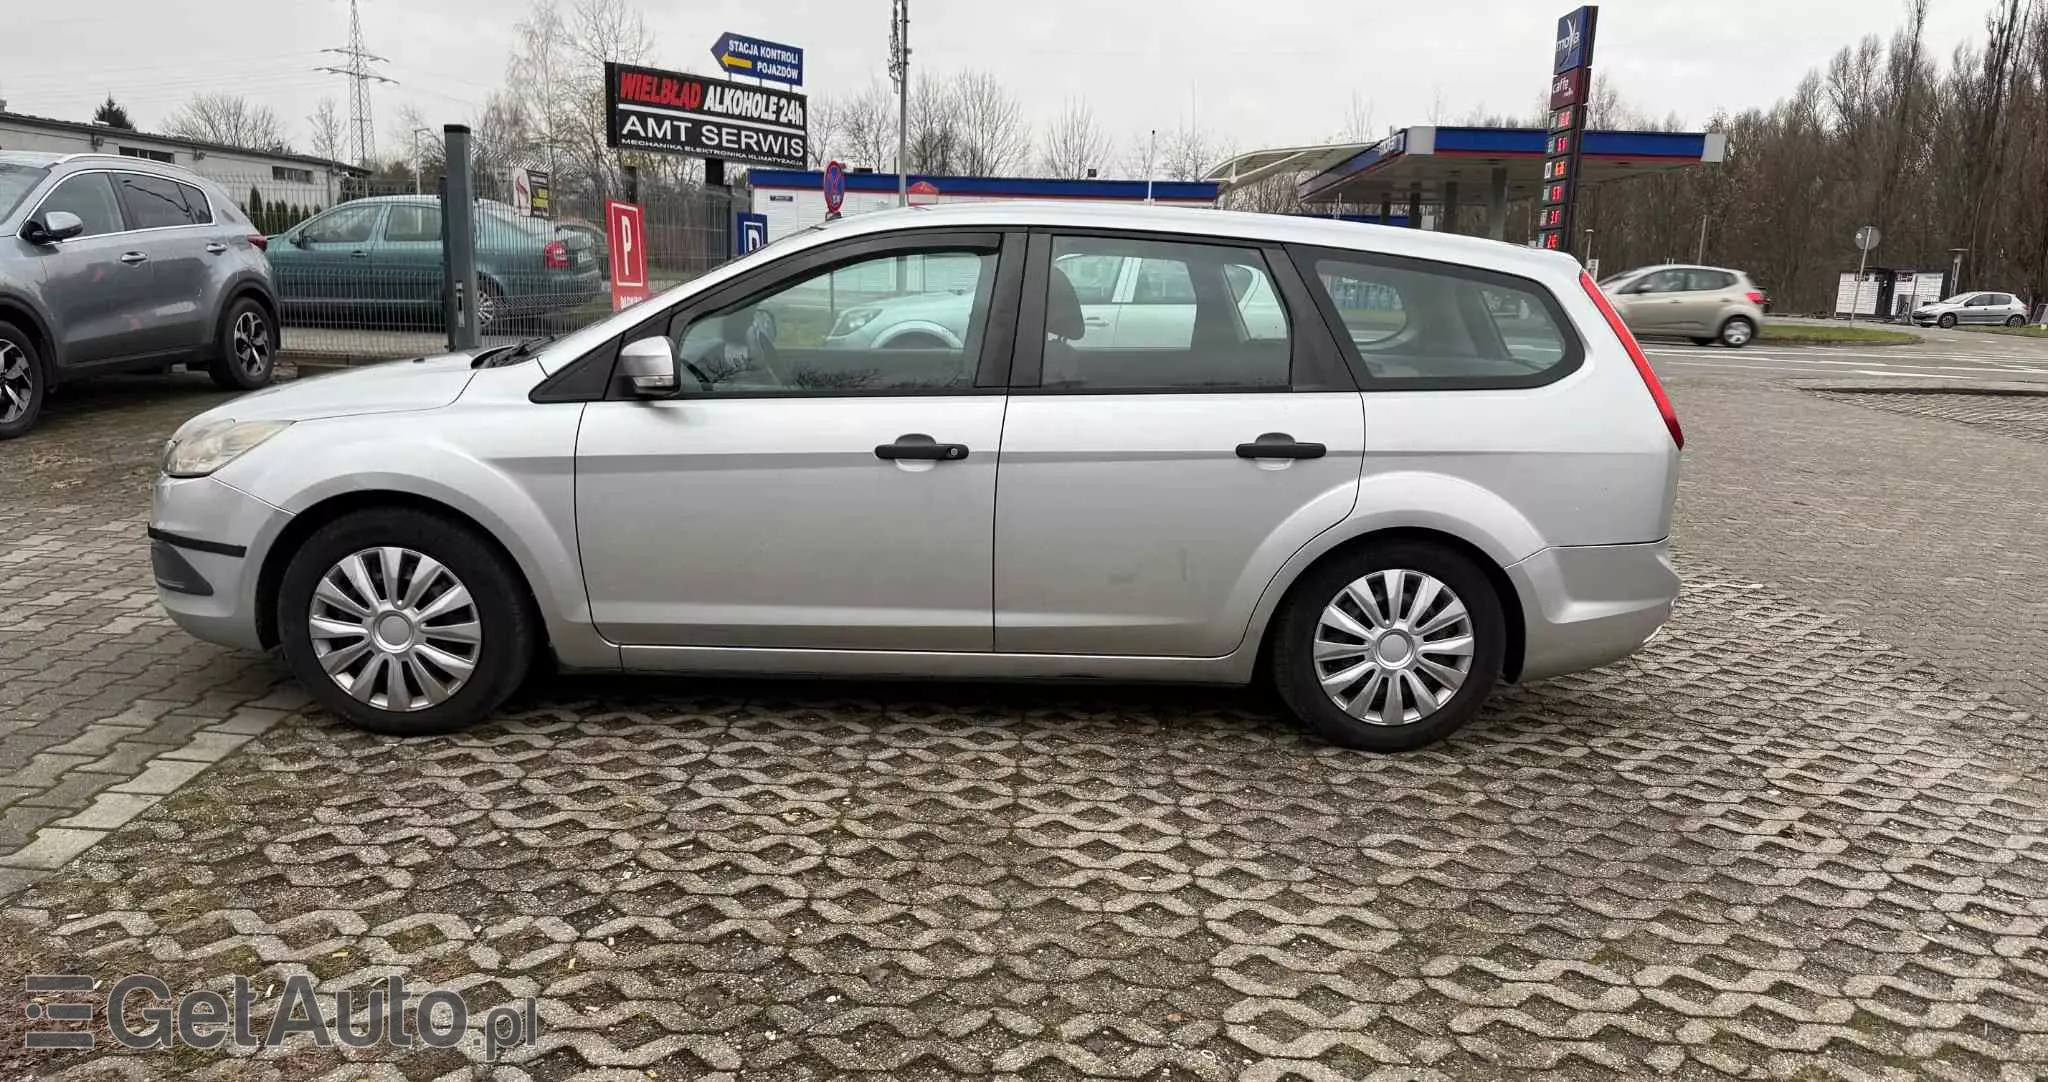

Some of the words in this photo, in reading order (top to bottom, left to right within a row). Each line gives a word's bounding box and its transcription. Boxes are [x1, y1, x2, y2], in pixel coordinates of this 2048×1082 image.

[728, 39, 759, 57] STACJA
[759, 46, 799, 64] KONTROLI
[756, 61, 799, 79] POJAZDÓW
[620, 71, 701, 110] WIELBŁĄD
[704, 85, 778, 121] ALKOHOLE
[779, 97, 804, 126] 24h
[621, 114, 693, 142] AMT
[700, 125, 804, 158] SERWIS
[621, 138, 683, 151] MECHANIKA
[684, 145, 746, 158] ELEKTRONIKA
[747, 153, 803, 167] KLIMATYZACJA
[621, 215, 632, 276] P
